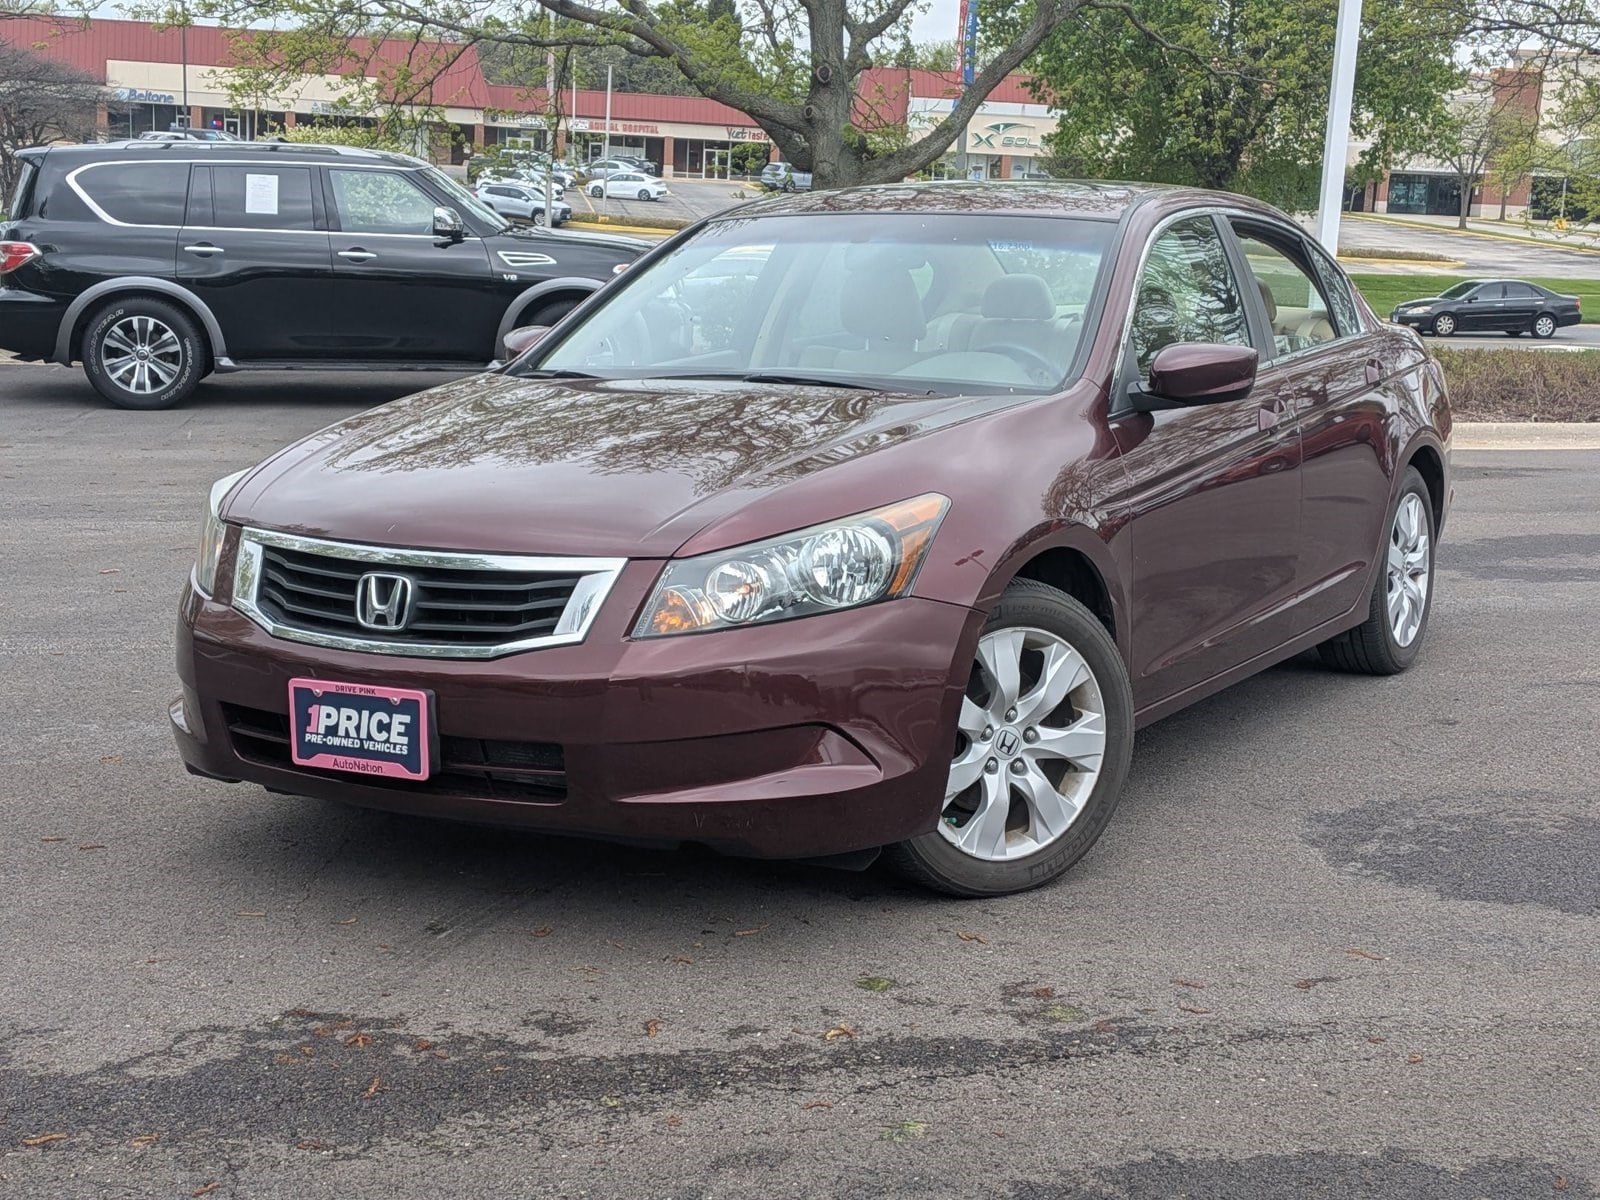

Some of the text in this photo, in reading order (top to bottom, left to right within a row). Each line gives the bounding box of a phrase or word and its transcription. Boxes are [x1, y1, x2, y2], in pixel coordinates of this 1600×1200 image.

[128, 88, 175, 103] Beltone
[622, 124, 659, 134] HOSPITAL
[1001, 136, 1041, 148] GOL
[335, 685, 356, 693] DRIVE
[305, 733, 408, 755] PRE-OWNED VEHICLES
[332, 758, 383, 774] AutoNation
